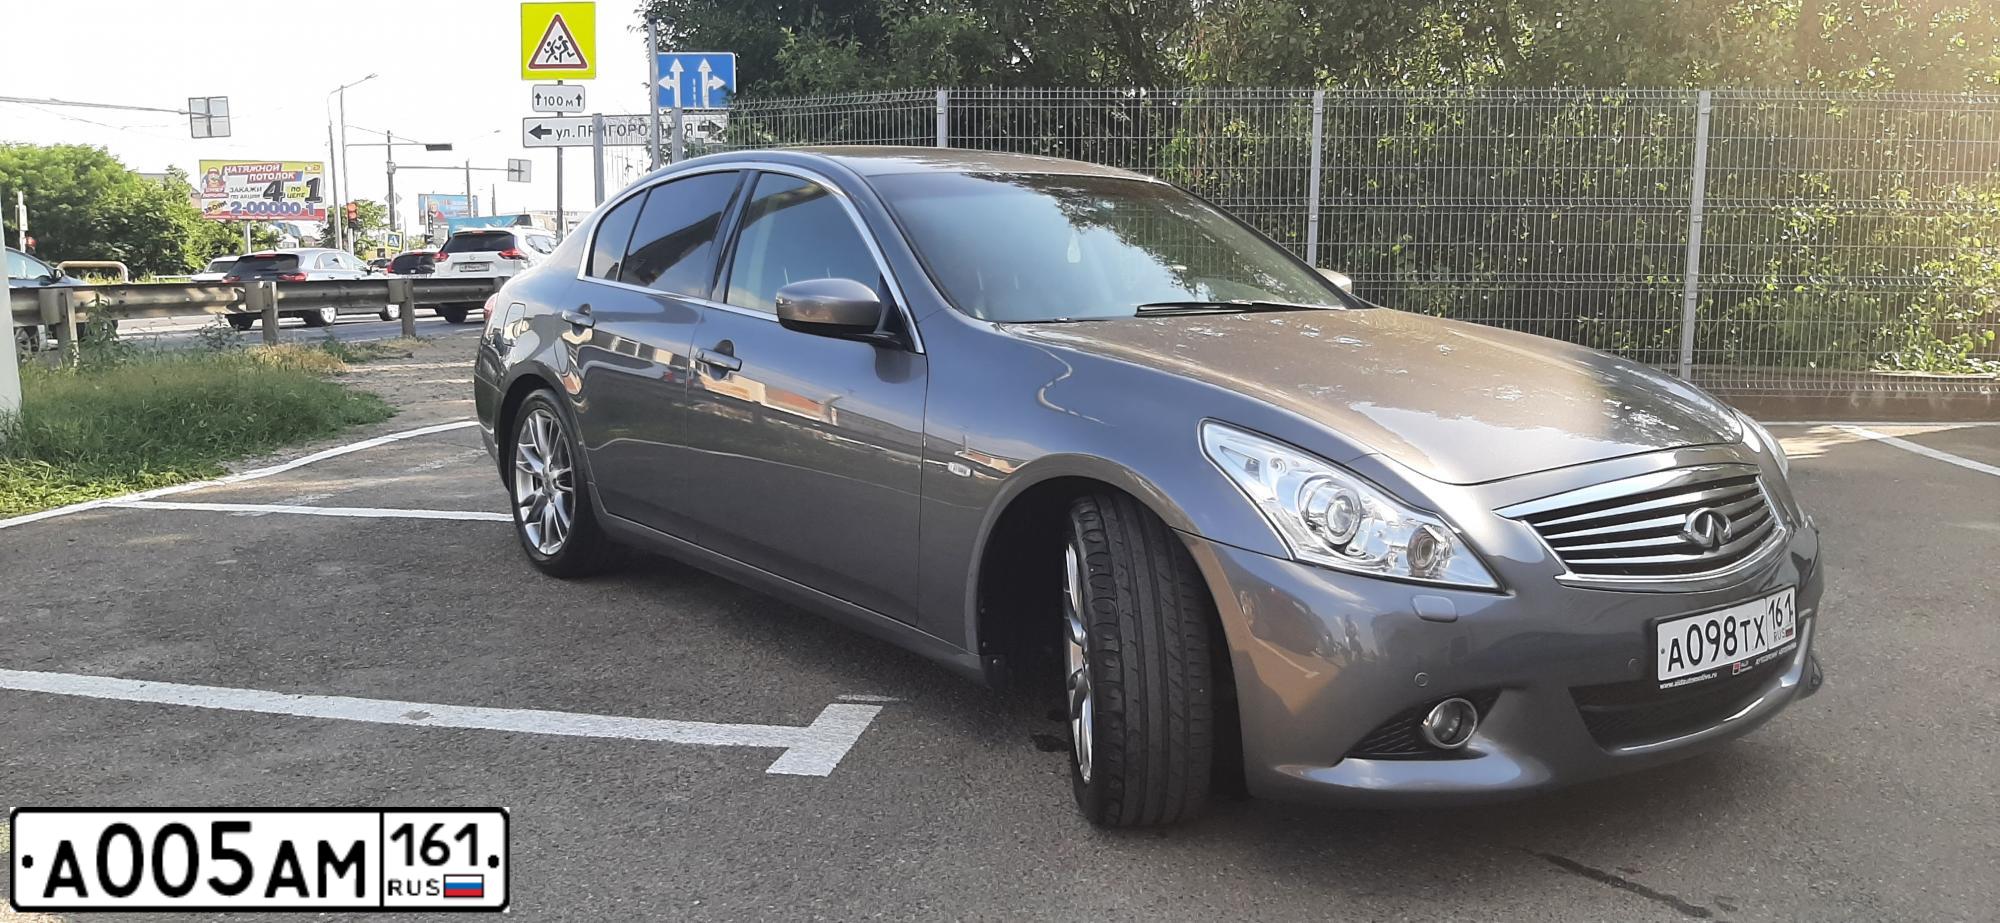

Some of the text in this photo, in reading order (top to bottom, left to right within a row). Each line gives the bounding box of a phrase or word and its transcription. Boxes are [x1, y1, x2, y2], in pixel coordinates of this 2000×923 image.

[224, 164, 280, 173] НАТЯЖНОЙ
[249, 172, 295, 181] ПОТОЛОК
[263, 180, 285, 202] 4
[304, 177, 323, 203] 1
[1768, 593, 1793, 630] 161
[1773, 629, 1786, 642] RUS
